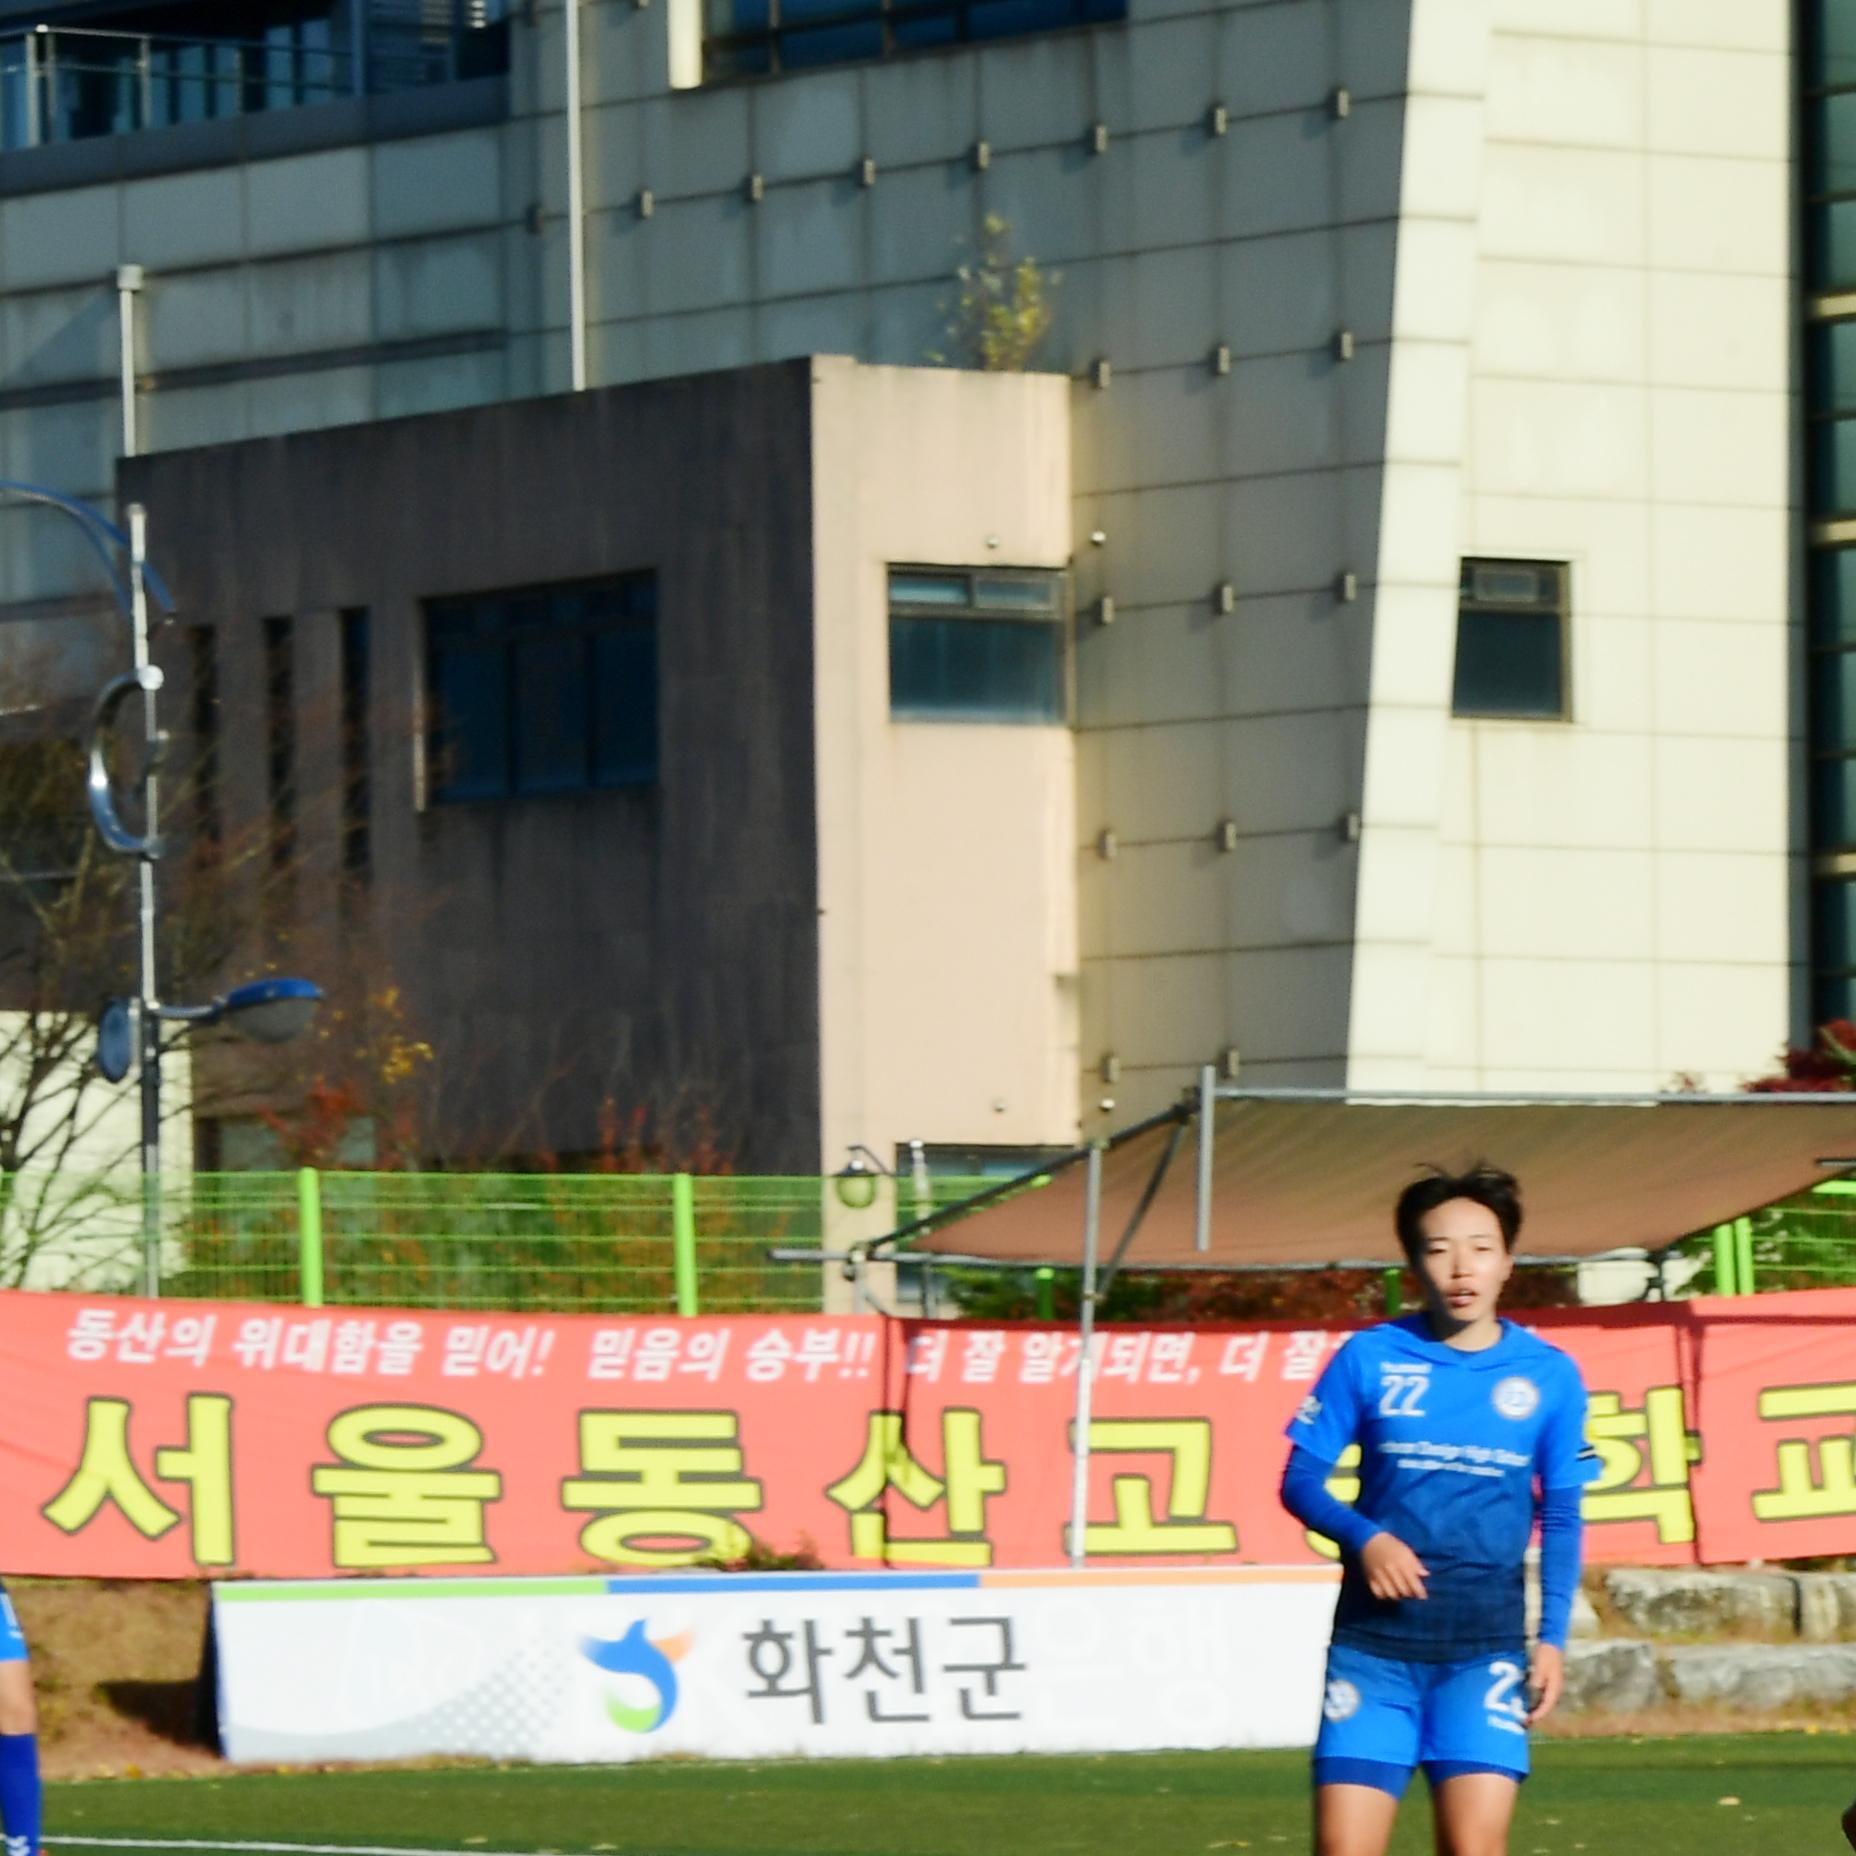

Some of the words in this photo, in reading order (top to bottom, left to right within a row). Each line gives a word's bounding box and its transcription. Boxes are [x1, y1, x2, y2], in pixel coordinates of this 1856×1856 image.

[67, 1309, 217, 1367] 동산의
[233, 1317, 423, 1375] 위대함을
[442, 1325, 556, 1379] 믿어!
[587, 1327, 731, 1382] 믿음의
[745, 1328, 876, 1382] 승부!!
[962, 1330, 1006, 1382] 잘
[1219, 1331, 1270, 1382] 더
[1280, 1331, 1354, 1380] 잘
[1379, 1376, 1430, 1417] 22
[741, 1616, 1028, 1725] 화천군
